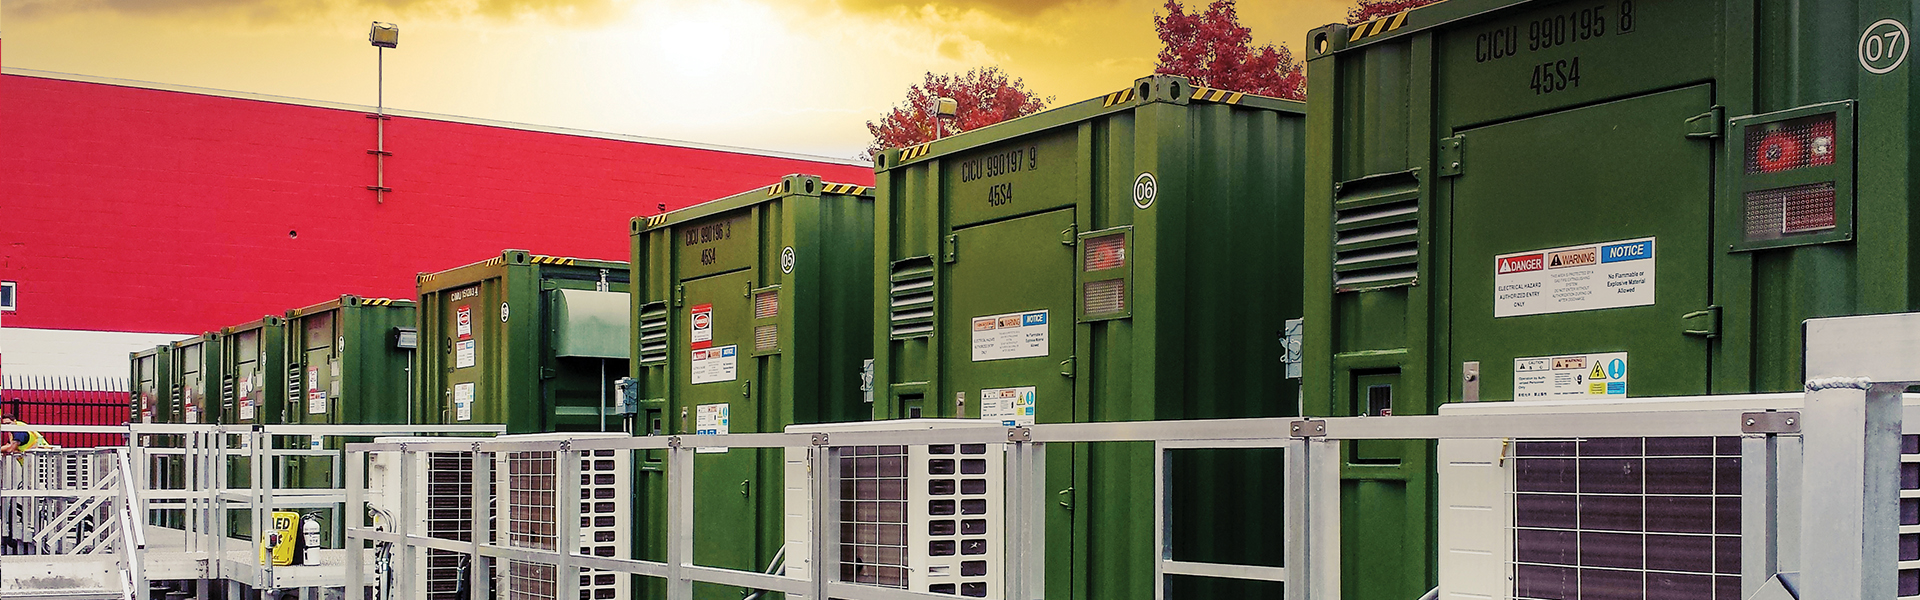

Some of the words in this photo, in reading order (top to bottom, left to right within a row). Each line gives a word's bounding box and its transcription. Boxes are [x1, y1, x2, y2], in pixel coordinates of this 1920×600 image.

[1475, 25, 1517, 63] CICU
[1529, 6, 1605, 51] 990195
[1620, 0, 1632, 31] 8
[1866, 31, 1901, 62] 07
[1530, 56, 1580, 95] 45S4
[961, 158, 982, 183] CICU
[986, 149, 1023, 178] 990197
[1029, 146, 1036, 169] 9
[988, 182, 1012, 207] 45S4
[1137, 181, 1153, 200] 06
[701, 247, 716, 266] 45S4
[783, 253, 793, 267] 05
[1562, 252, 1595, 265] WARNING
[1609, 244, 1644, 258] NOTICE
[1511, 259, 1542, 272] DANGER
